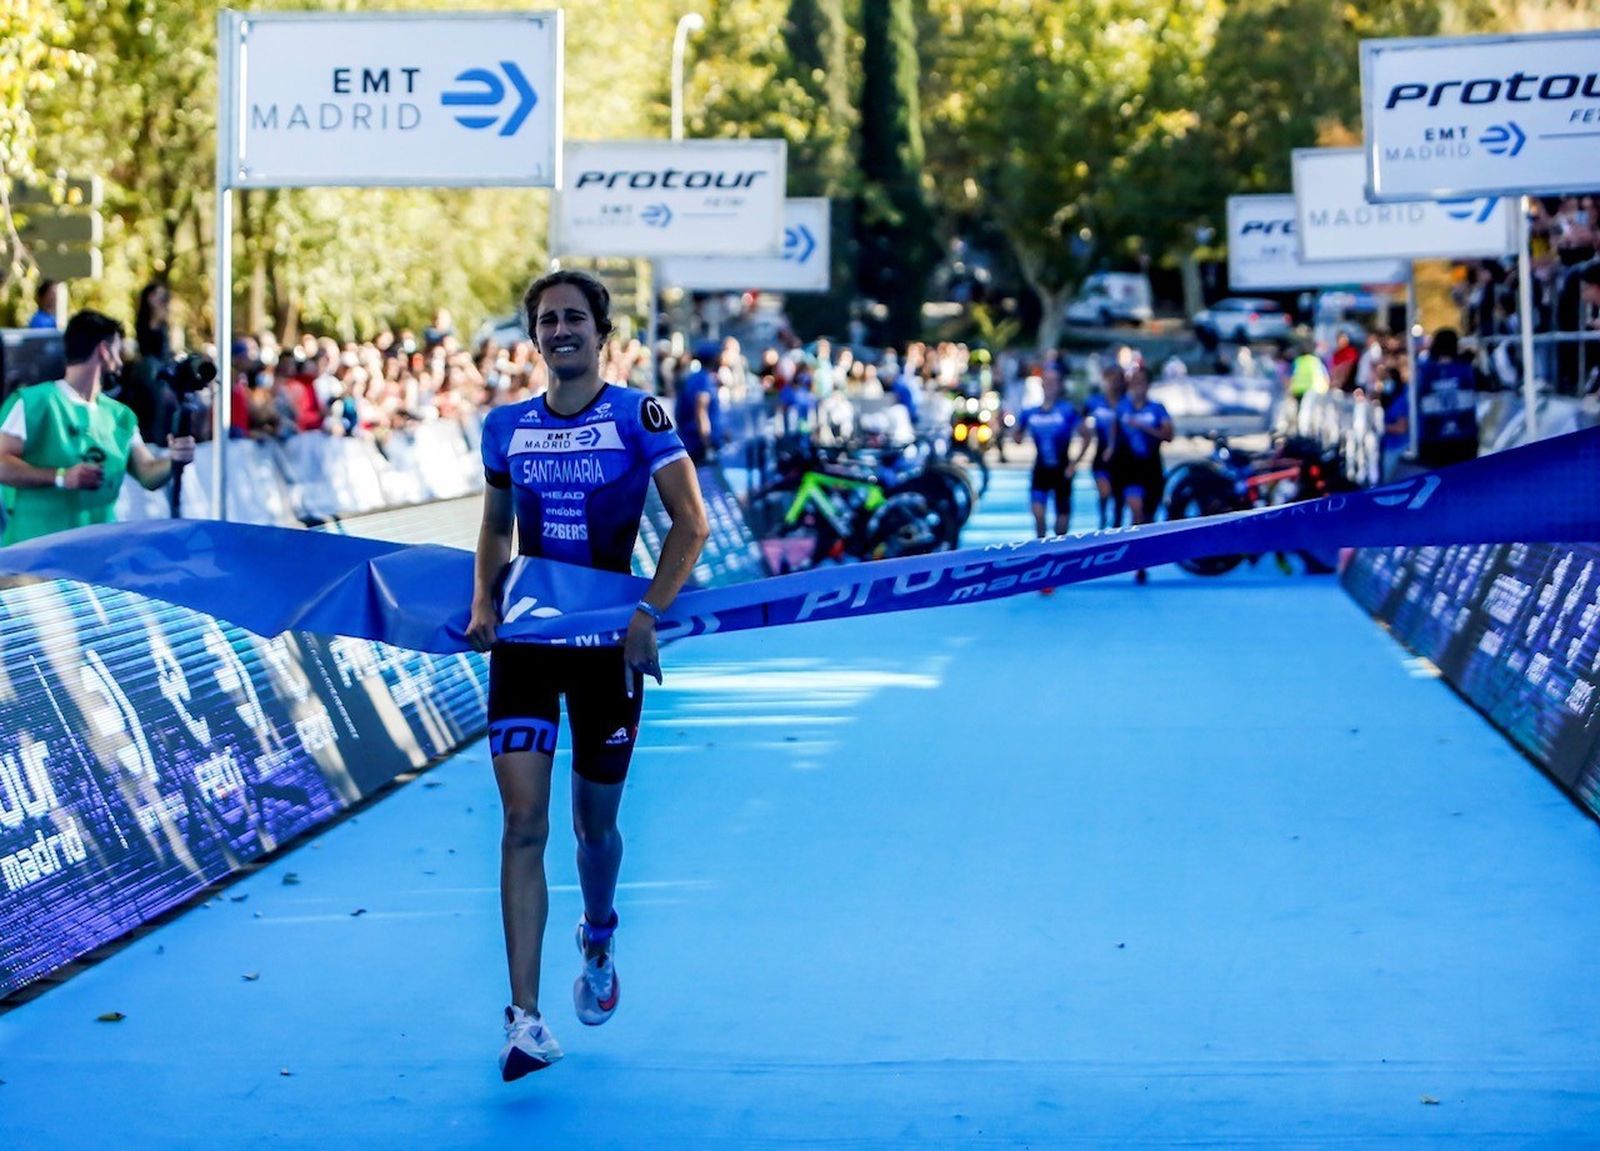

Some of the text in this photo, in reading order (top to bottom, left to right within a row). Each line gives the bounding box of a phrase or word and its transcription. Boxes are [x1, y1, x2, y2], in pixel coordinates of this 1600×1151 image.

[333, 68, 421, 94] EMT
[252, 104, 422, 130] MADRID
[1424, 126, 1468, 141] EMT
[1385, 143, 1471, 161] MADRID
[1309, 204, 1424, 227] MADRID
[524, 440, 571, 449] MADRID
[547, 431, 572, 441] EMT
[523, 453, 605, 484] SANTAMARÍA
[541, 491, 585, 500] HEAD
[542, 521, 589, 540] 226ERS
[948, 543, 1129, 602] madrid
[0, 816, 87, 891] madrid
